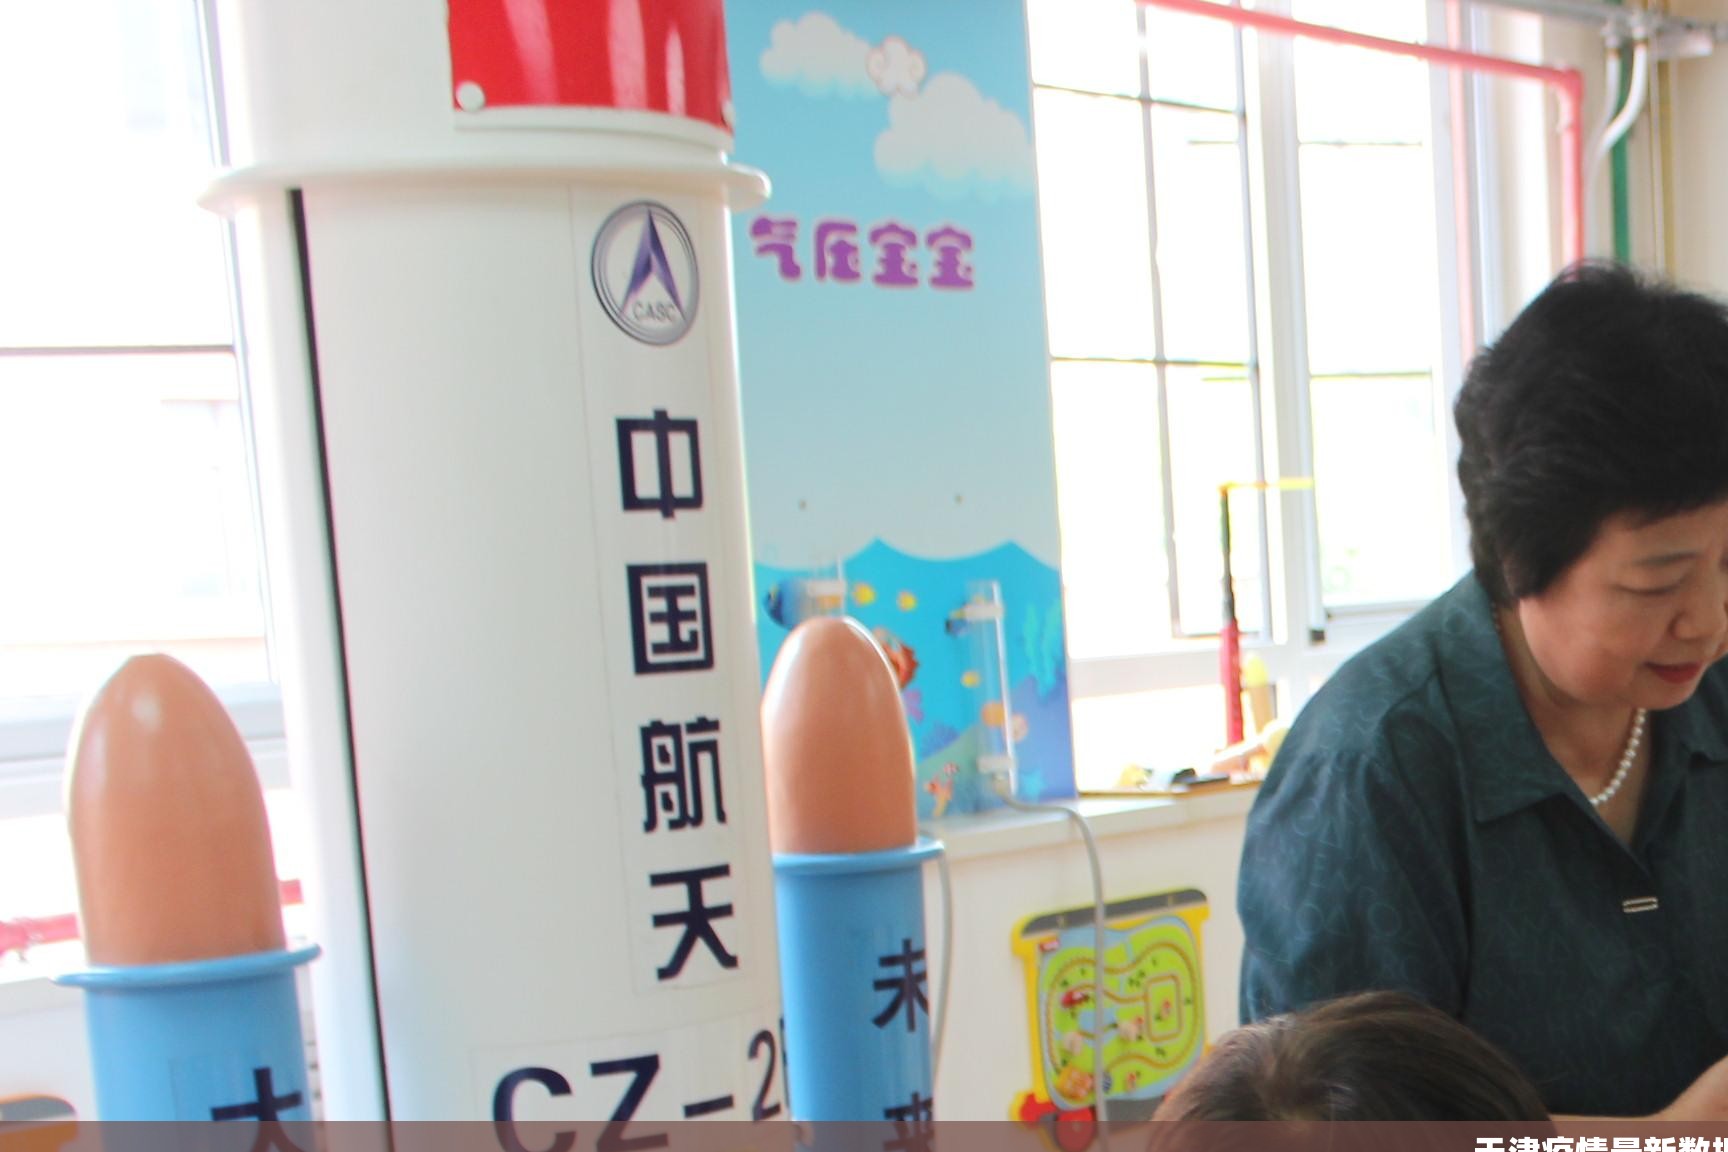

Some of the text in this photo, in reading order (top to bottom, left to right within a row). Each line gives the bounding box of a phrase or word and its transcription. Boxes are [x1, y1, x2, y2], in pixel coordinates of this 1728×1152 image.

[749, 215, 976, 290] 气压宝宝
[632, 300, 676, 323] CASC
[616, 409, 739, 981] 中国航天
